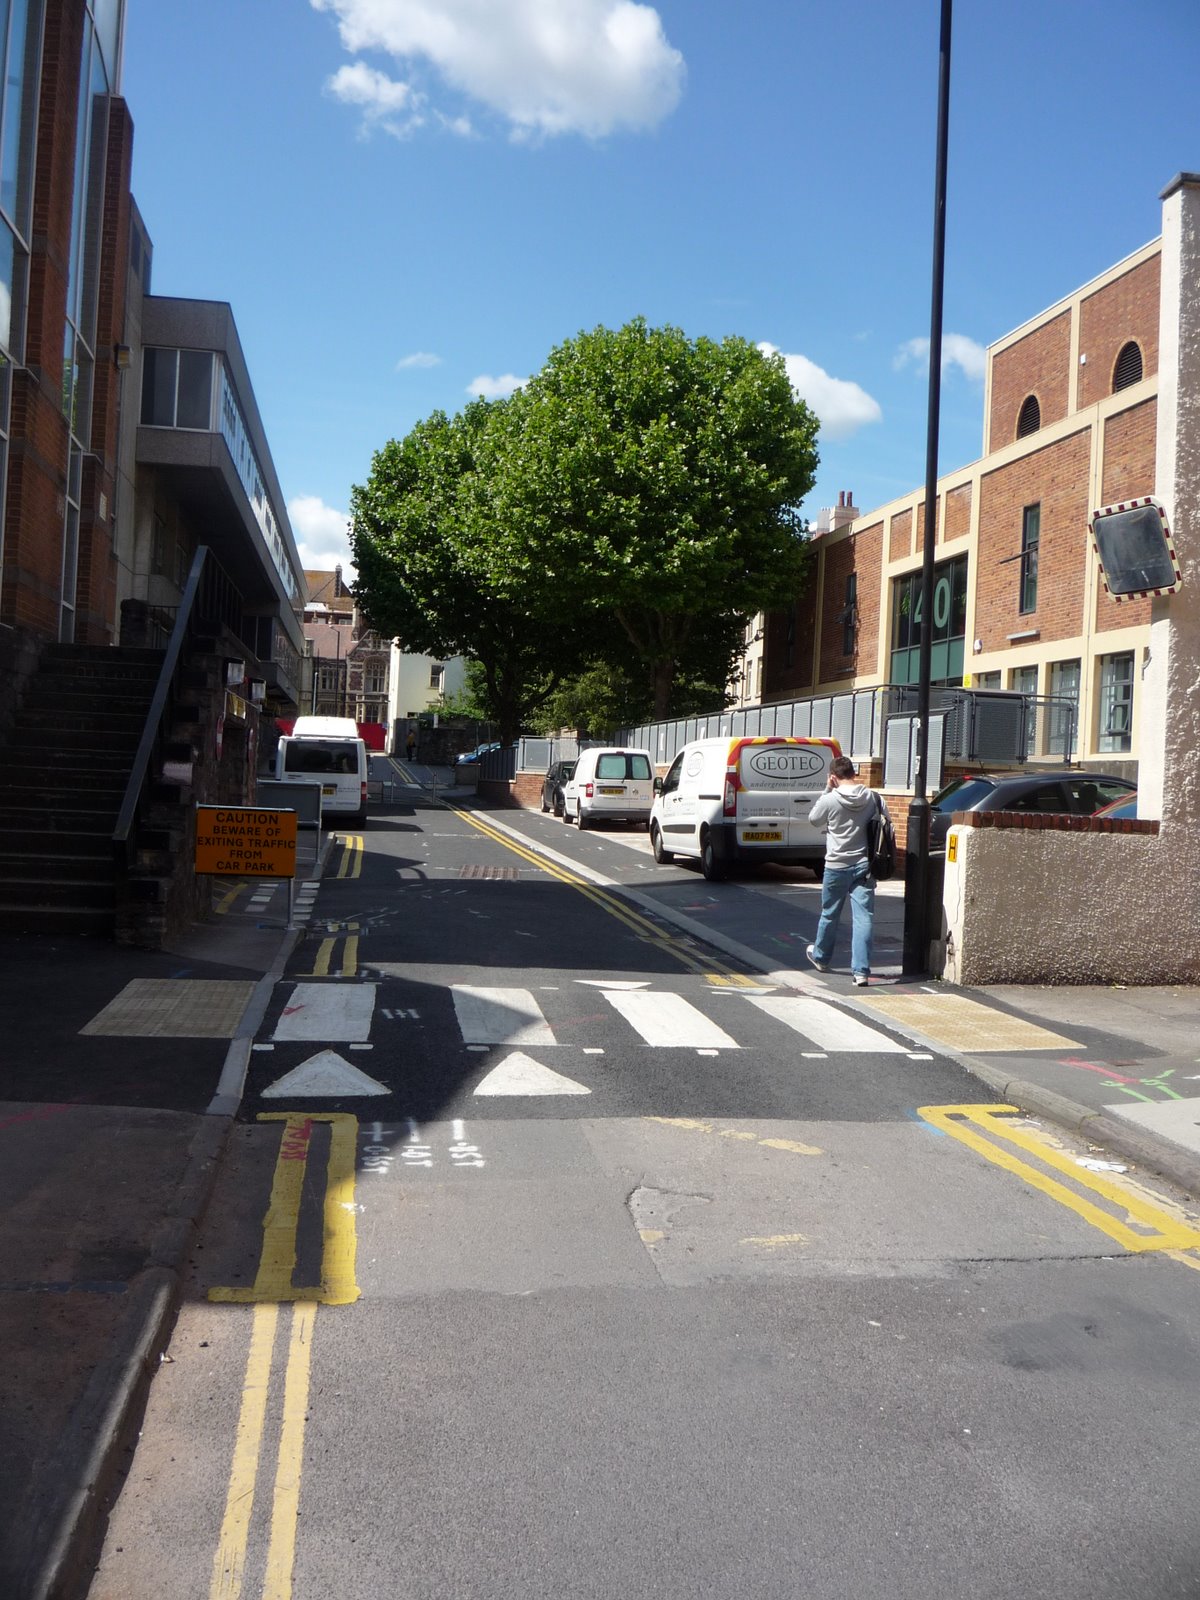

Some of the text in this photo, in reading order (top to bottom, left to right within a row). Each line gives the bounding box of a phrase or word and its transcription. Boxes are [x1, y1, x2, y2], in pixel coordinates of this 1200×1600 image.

[756, 756, 819, 771] GEOTEC
[750, 780, 797, 789] underground
[216, 812, 279, 825] CAUTION
[213, 825, 281, 837] BEWARE OF
[197, 836, 296, 849] EXITING TRAFFIC
[230, 850, 262, 860] FROM
[216, 861, 274, 872] CAR PARK
